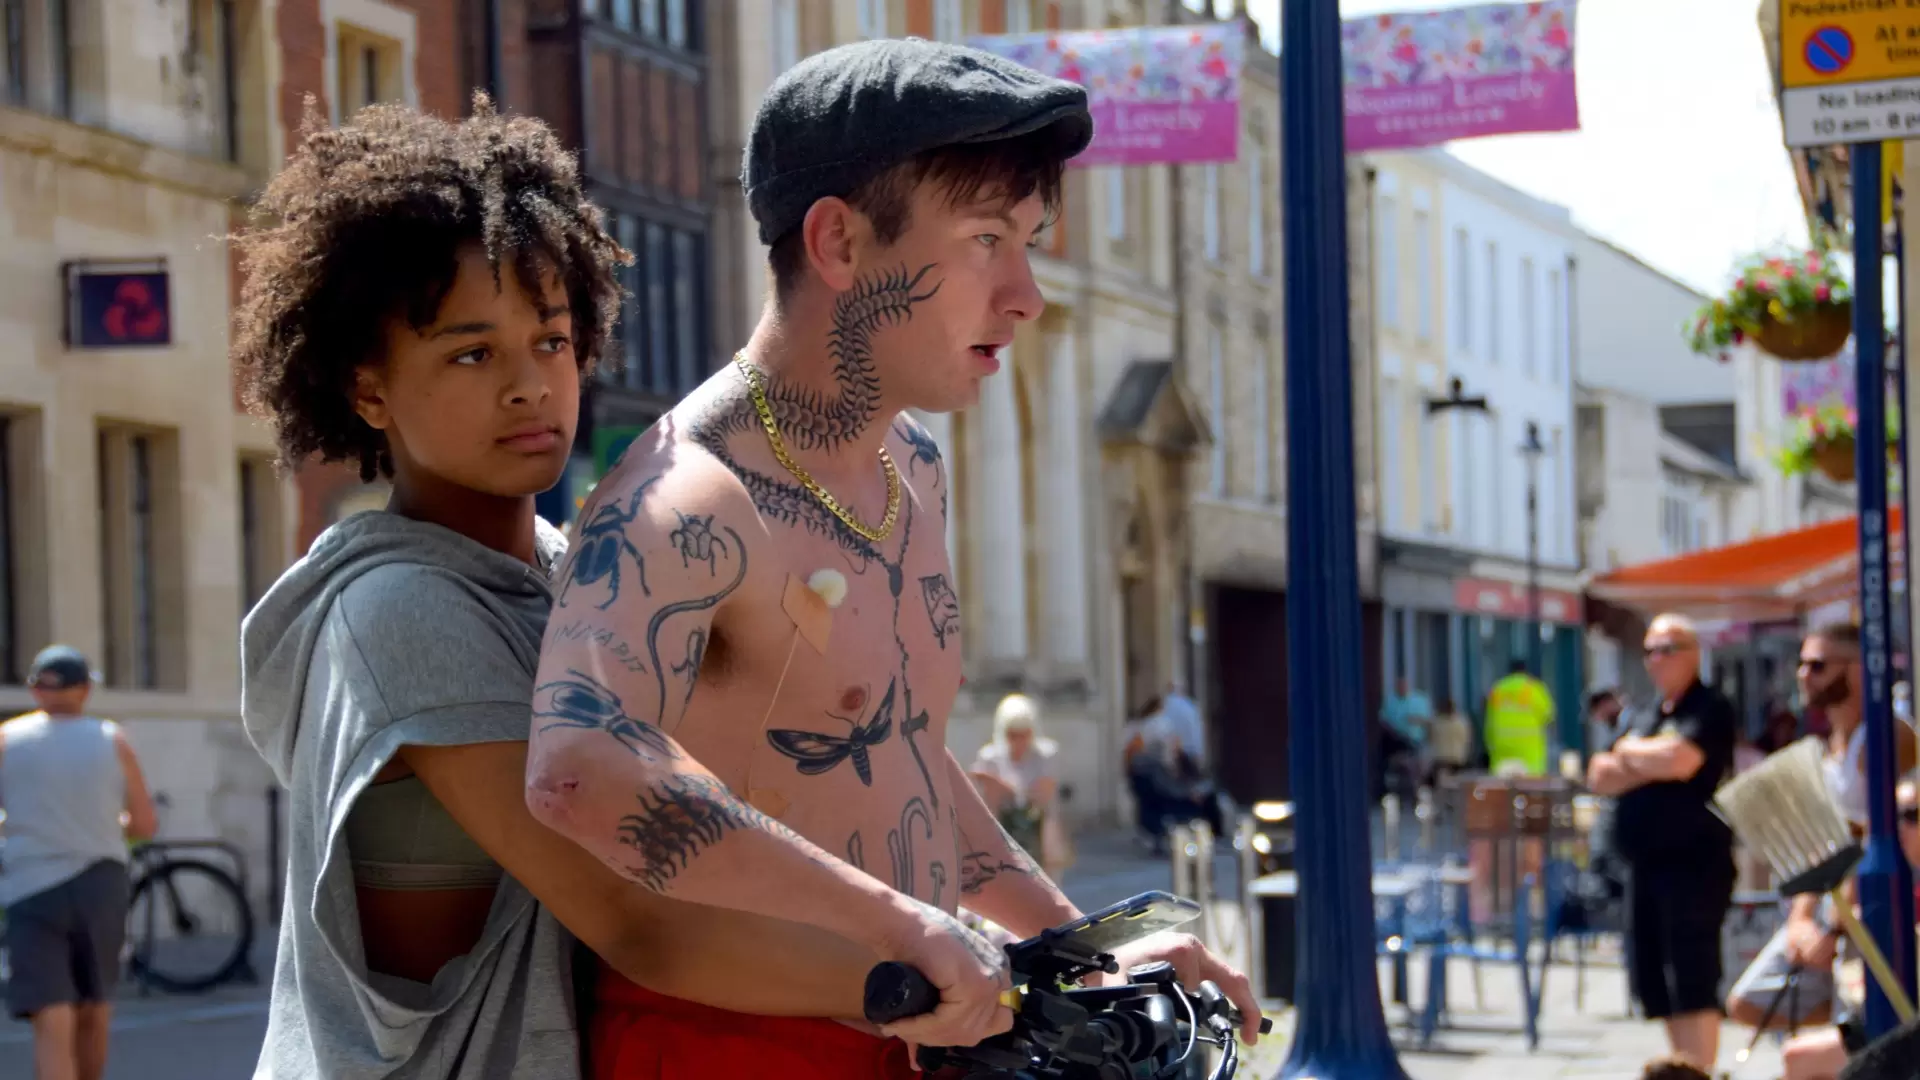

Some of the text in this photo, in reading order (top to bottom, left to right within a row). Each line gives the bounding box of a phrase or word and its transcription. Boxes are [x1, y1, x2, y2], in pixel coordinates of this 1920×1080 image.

[1819, 93, 1848, 109] No
[1814, 117, 1836, 135] 10
[1842, 119, 1870, 132] am
